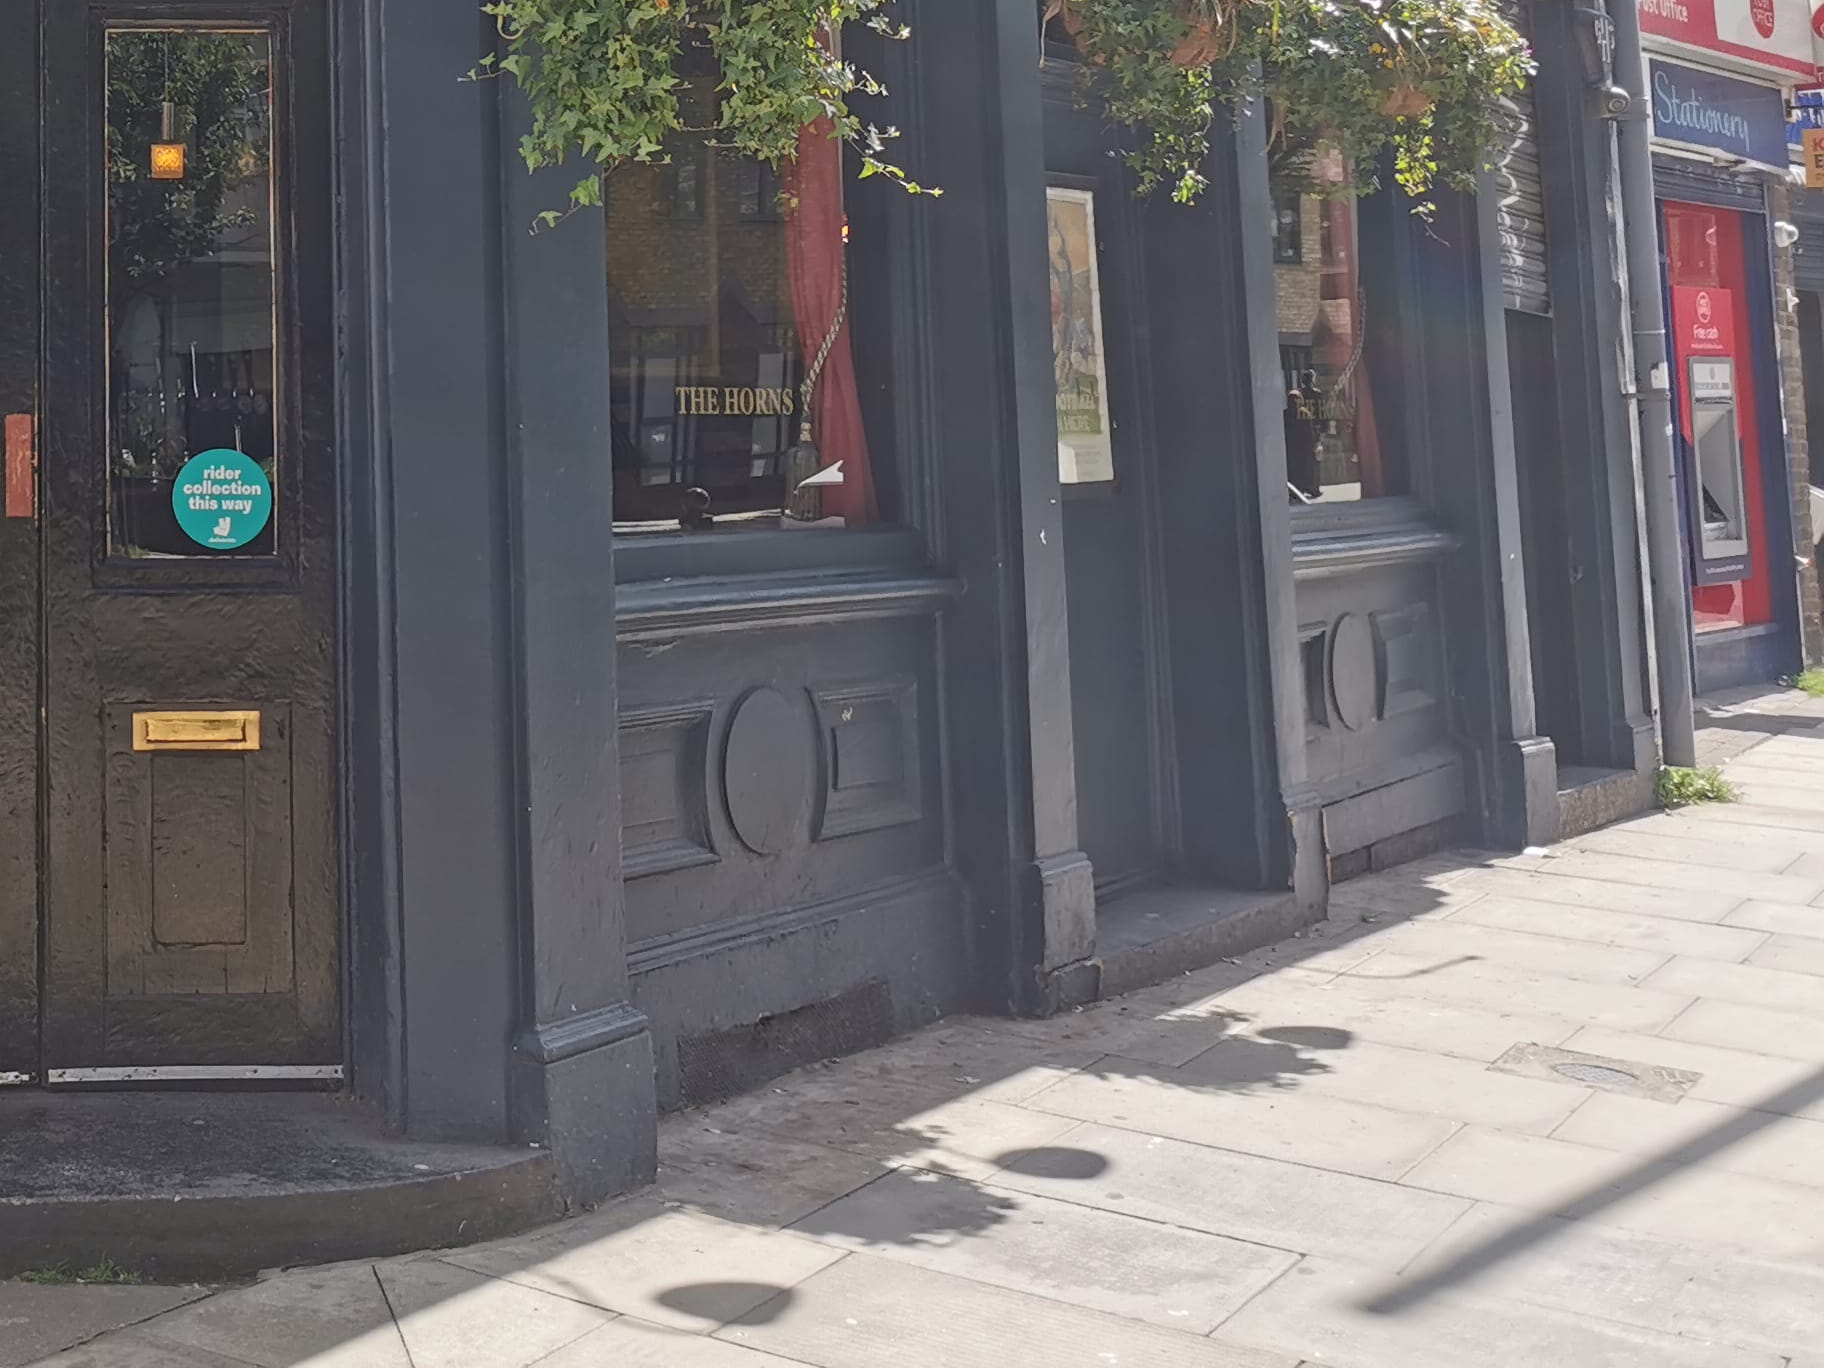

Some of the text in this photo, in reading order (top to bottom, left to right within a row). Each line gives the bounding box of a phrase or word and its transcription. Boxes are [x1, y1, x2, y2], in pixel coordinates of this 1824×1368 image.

[1655, 70, 1750, 153] Stationery
[675, 386, 795, 416] THE HORNS
[202, 465, 242, 480] rider
[182, 480, 262, 495] collection
[188, 495, 253, 515] this way
